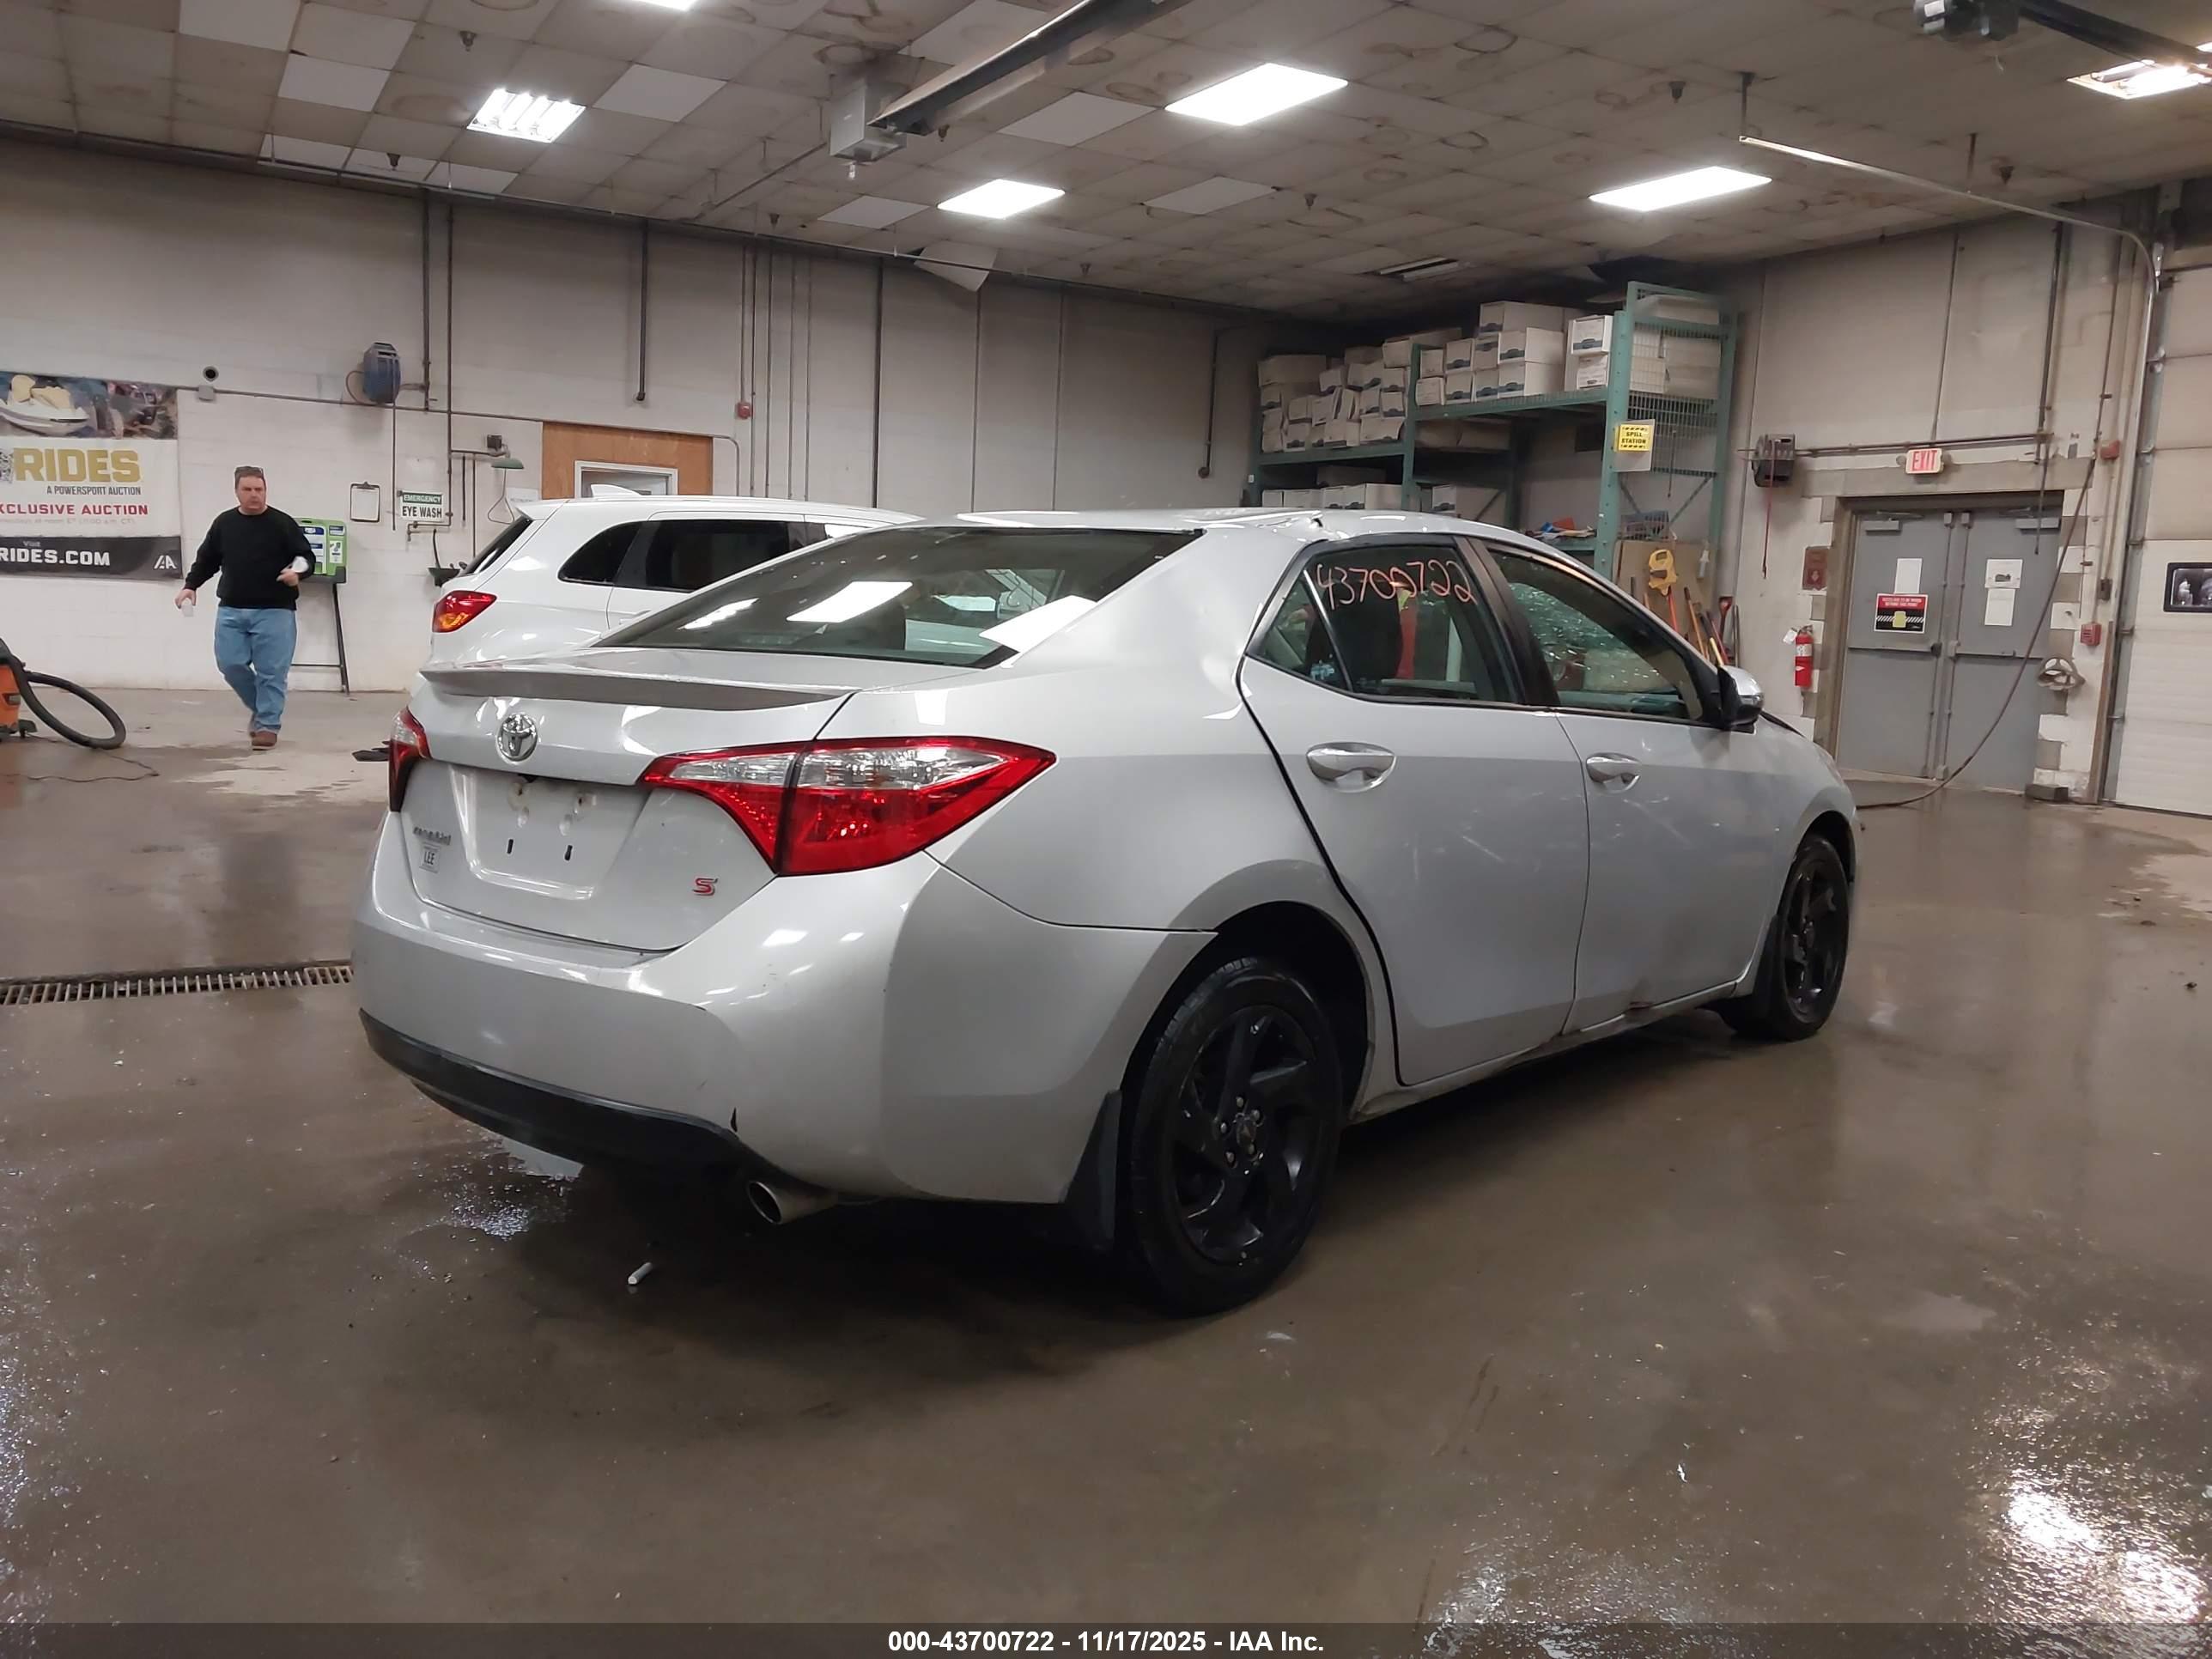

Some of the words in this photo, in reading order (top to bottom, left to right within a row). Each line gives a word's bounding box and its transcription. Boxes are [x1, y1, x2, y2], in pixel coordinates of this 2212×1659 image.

[14, 448, 141, 483] RIDES
[1912, 450, 1938, 471] EXIT
[46, 486, 52, 495] A
[54, 486, 106, 495] POWERSPORT
[108, 487, 141, 495] AUCTION
[404, 495, 441, 503] EMERGENCY
[82, 504, 148, 515] AUCTION
[403, 506, 417, 516] EYE
[420, 507, 441, 518] WASH
[1316, 559, 1478, 610] 43700722
[692, 878, 719, 896] S
